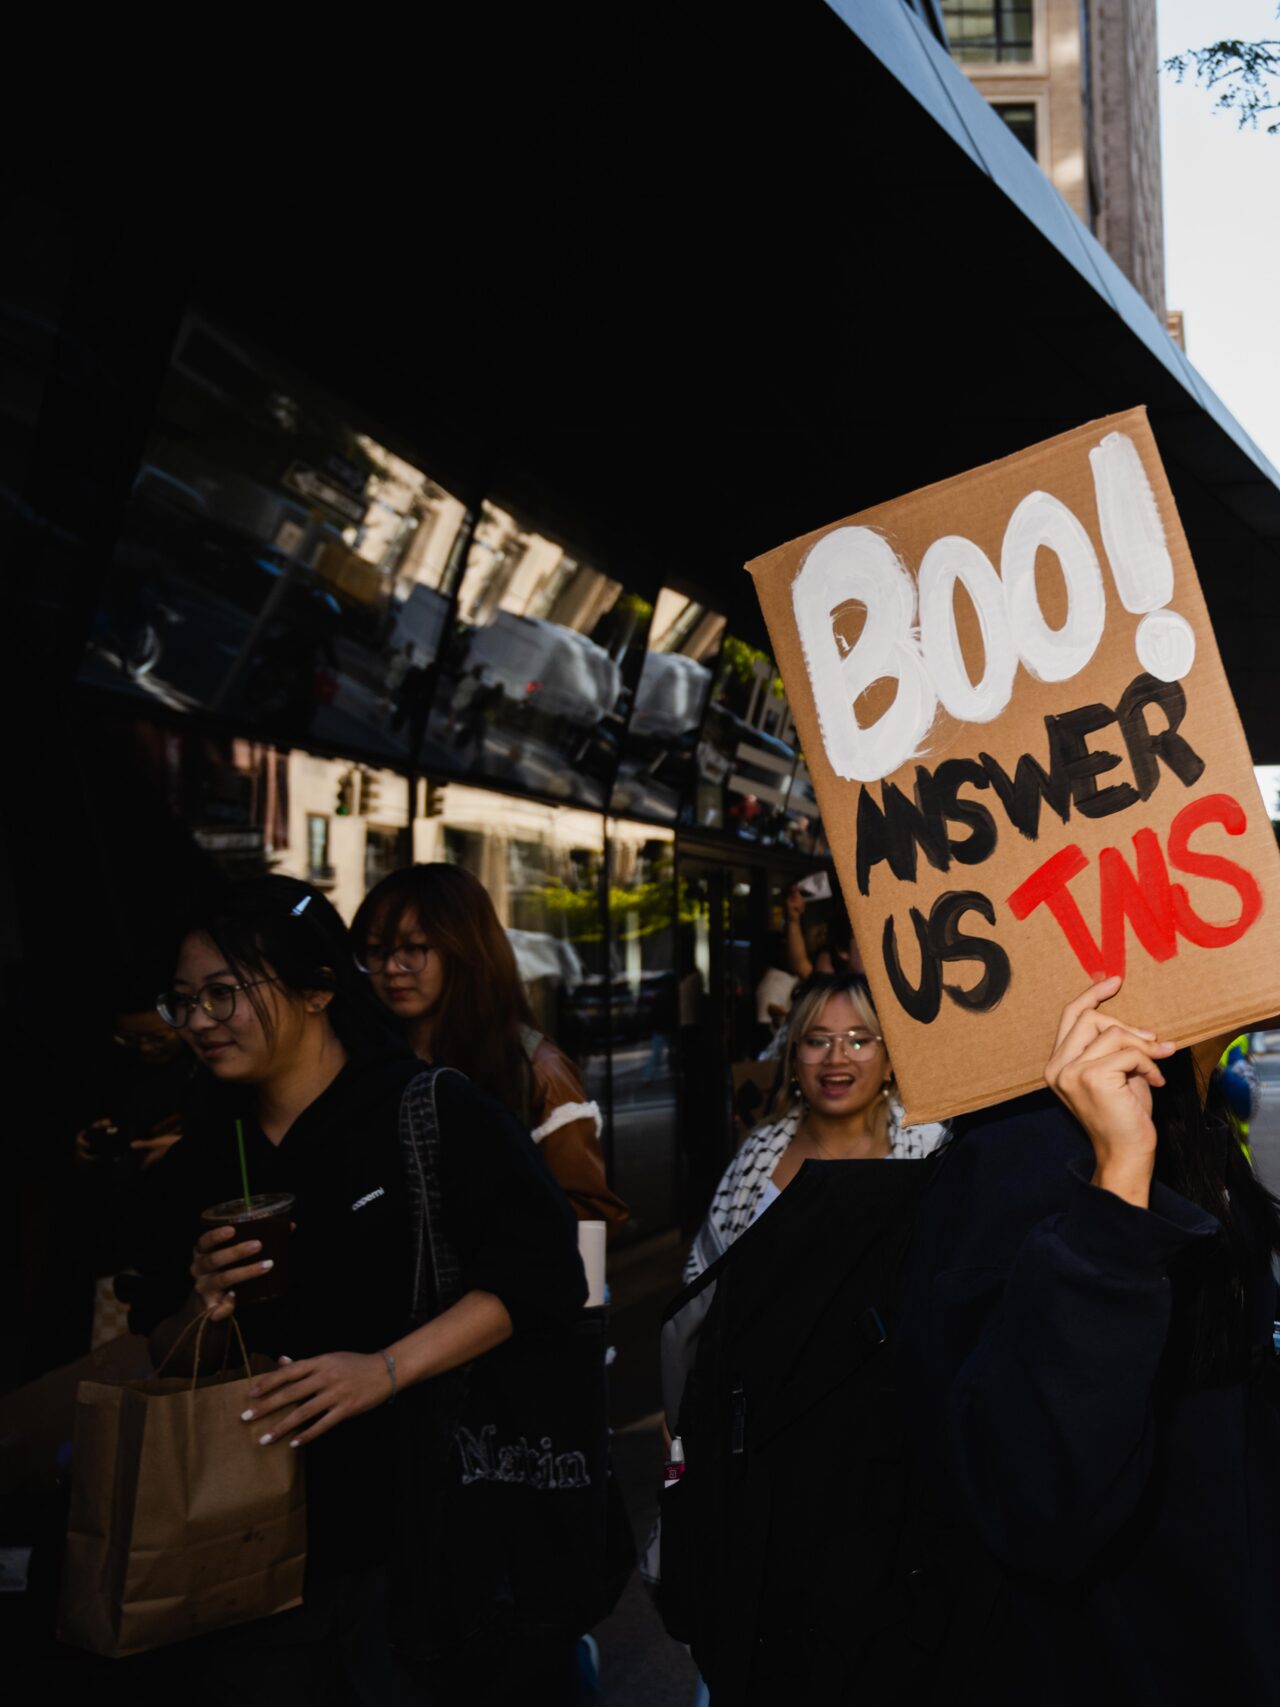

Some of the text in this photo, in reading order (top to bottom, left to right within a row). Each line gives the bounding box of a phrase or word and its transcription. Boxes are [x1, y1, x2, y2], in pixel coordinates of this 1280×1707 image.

[792, 431, 1195, 782] BOO!
[855, 673, 1205, 896] ANSWER
[882, 793, 1263, 1024] US TNS
